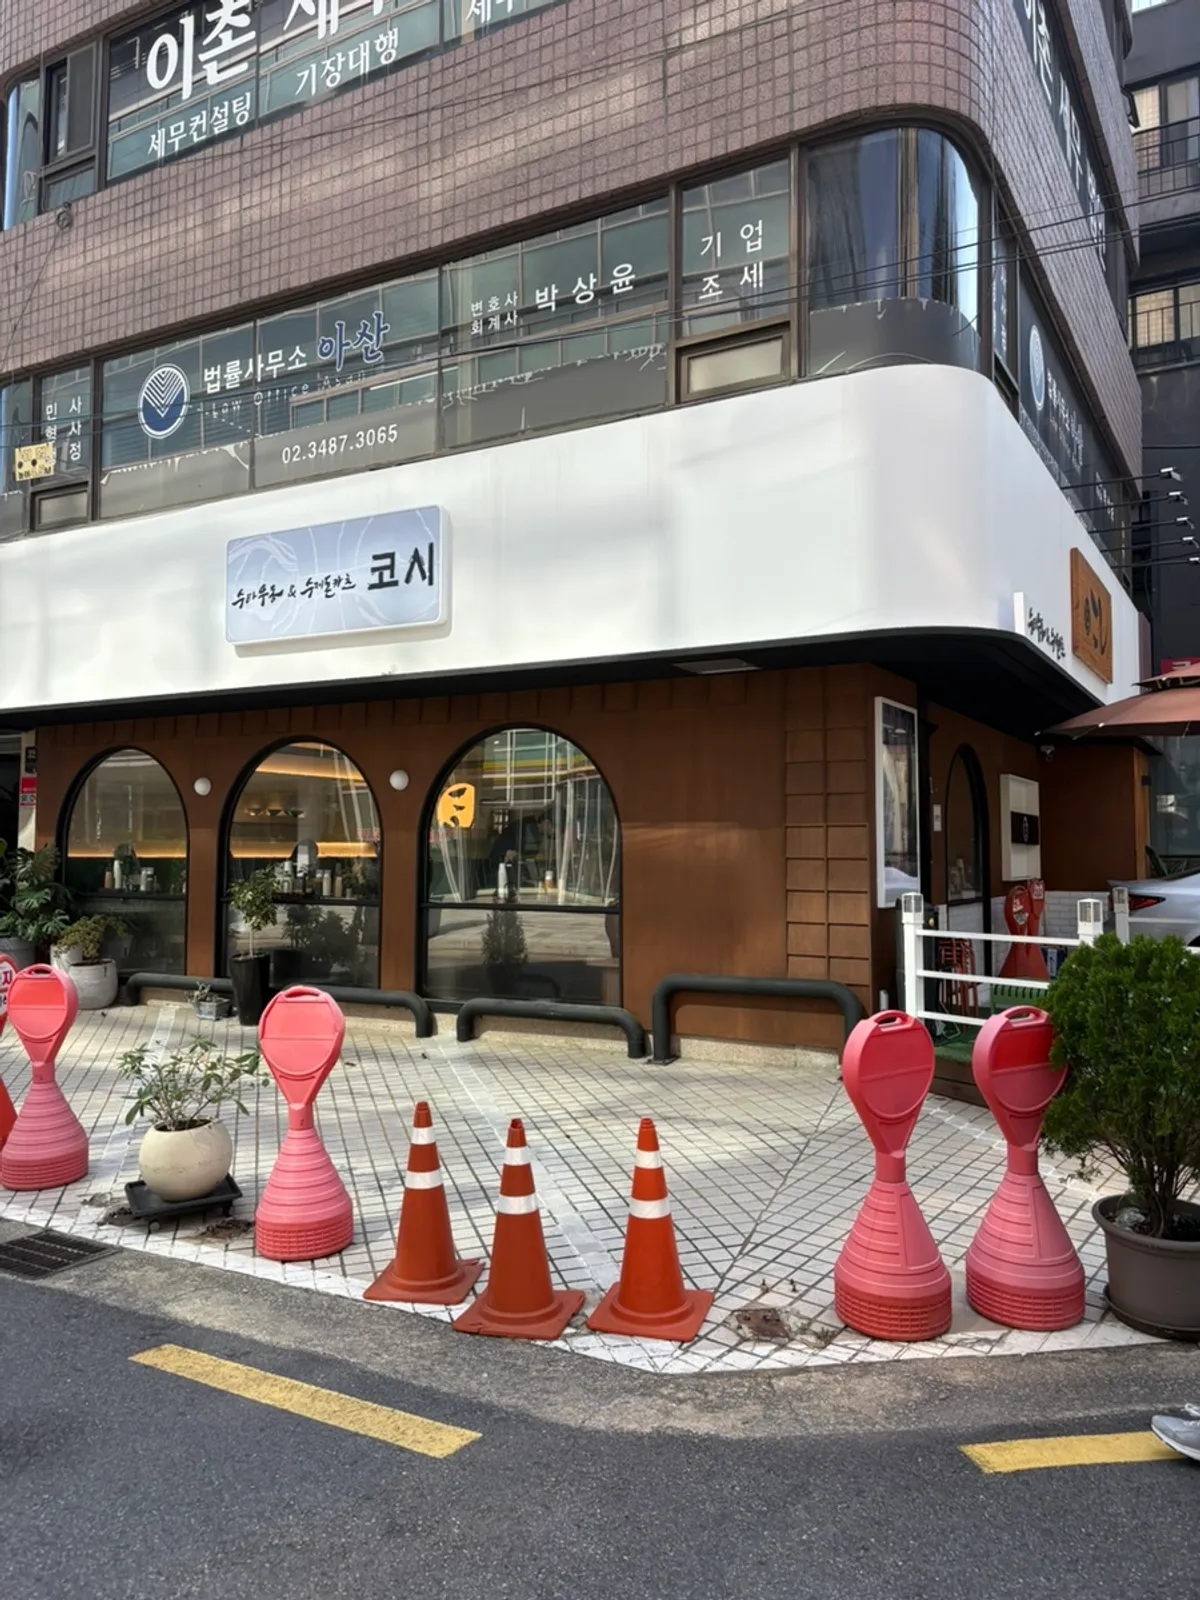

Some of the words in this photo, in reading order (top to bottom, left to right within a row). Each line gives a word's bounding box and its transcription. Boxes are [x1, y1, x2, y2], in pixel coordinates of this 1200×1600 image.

[147, 0, 256, 101] 이촌
[294, 27, 398, 96] 기장대행
[147, 92, 251, 159] 세무컨설팅
[700, 219, 763, 258] 기업
[470, 290, 518, 317] 변호사
[535, 263, 636, 312] 박상윤
[698, 261, 763, 300] 조세
[470, 312, 518, 336] 회계사
[203, 345, 308, 395] 법률사무소
[317, 310, 391, 372] 아산
[281, 423, 399, 464] 02.3487.3065
[367, 542, 435, 591] 코시
